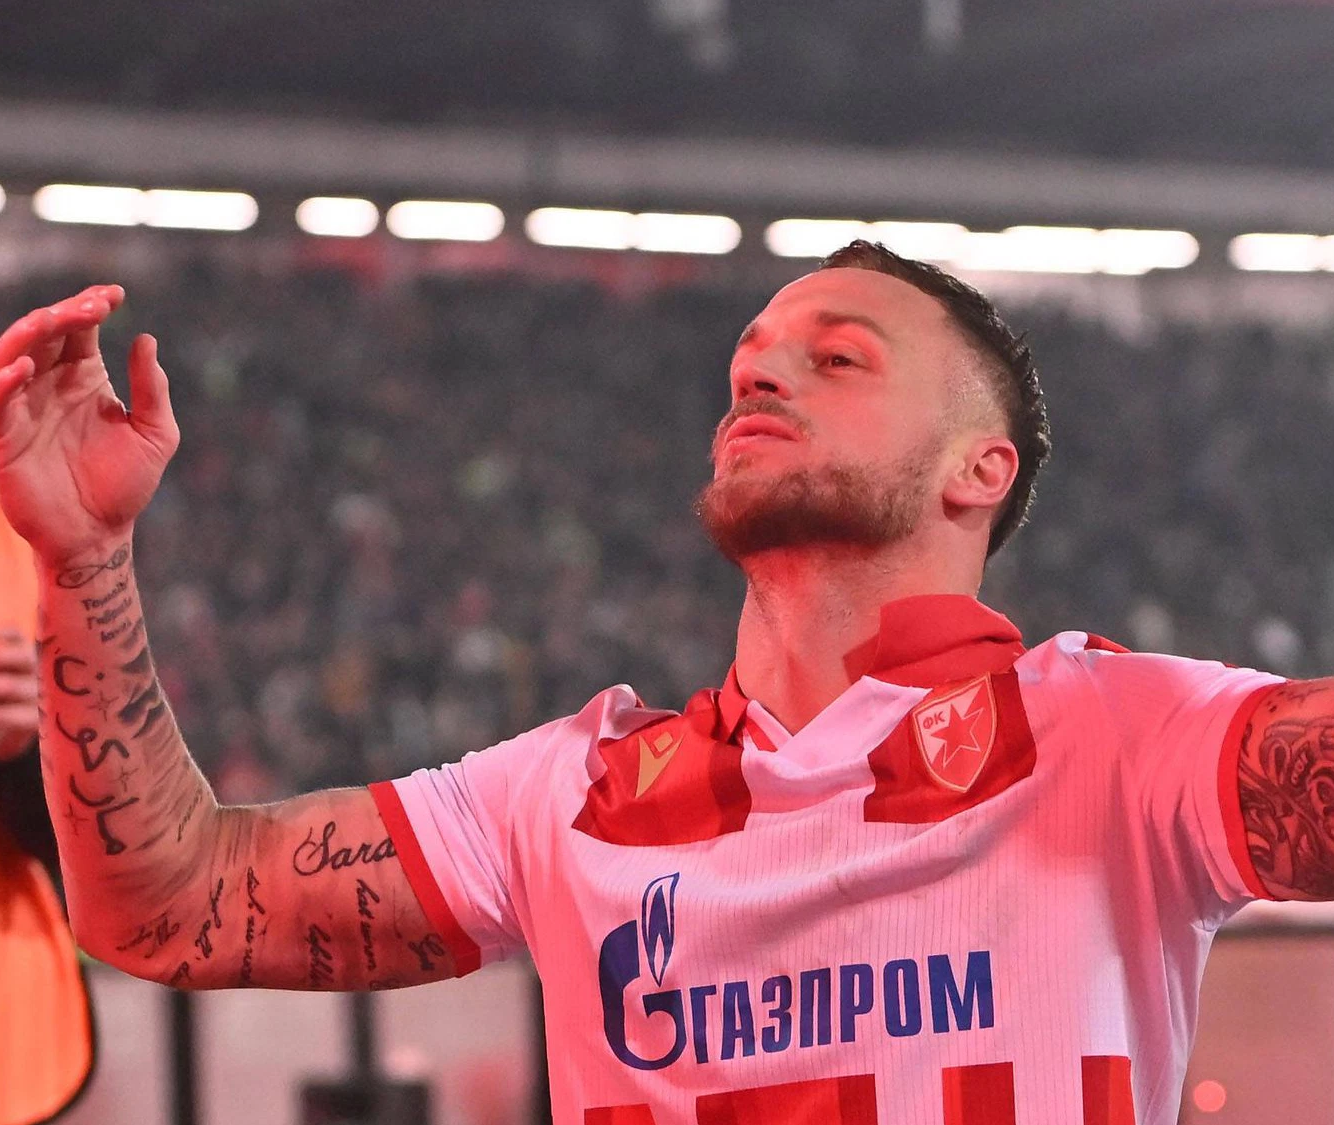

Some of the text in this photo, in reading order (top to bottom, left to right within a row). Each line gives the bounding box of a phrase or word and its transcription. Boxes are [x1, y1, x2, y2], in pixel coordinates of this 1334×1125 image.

[923, 711, 946, 730] ФК
[293, 821, 398, 876] Sara
[690, 950, 994, 1064] ГАЗПРОМ
